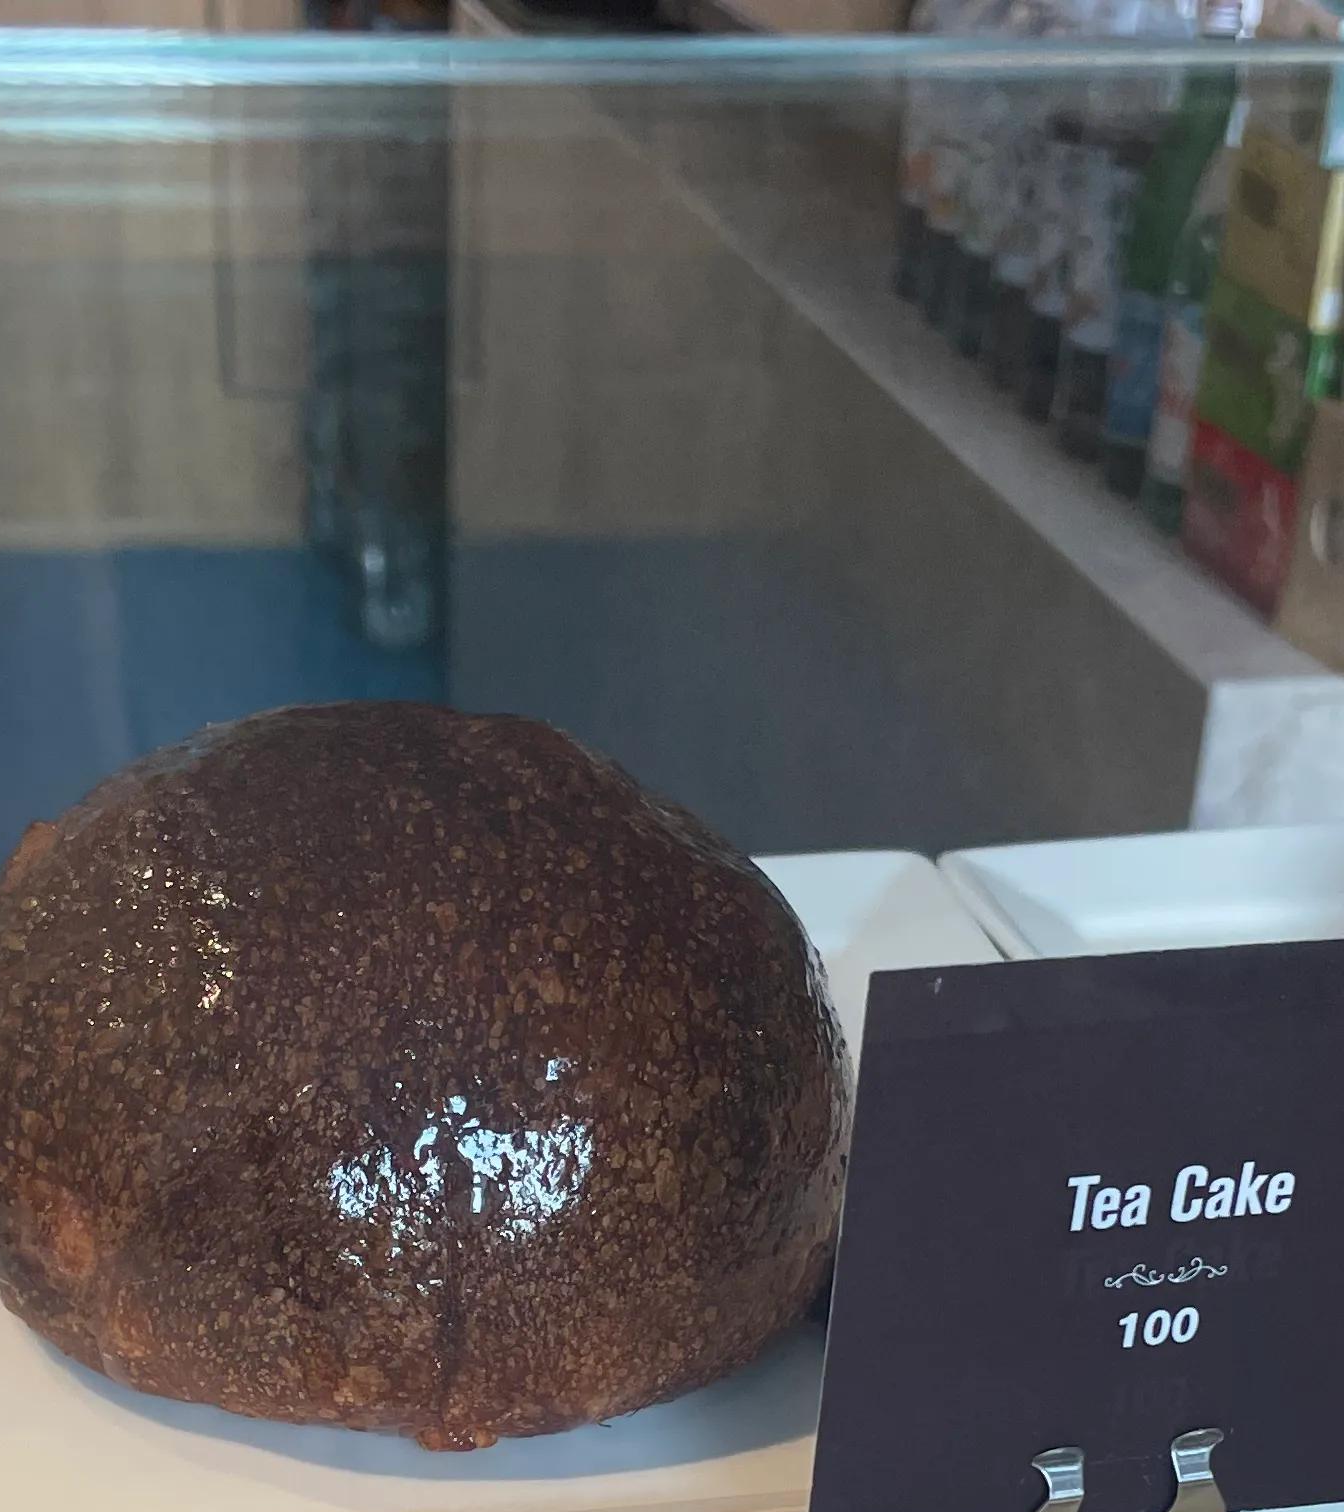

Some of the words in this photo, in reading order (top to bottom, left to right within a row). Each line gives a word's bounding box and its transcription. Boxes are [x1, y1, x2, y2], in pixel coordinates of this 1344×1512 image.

[1067, 1174, 1152, 1232] Tea
[1169, 1160, 1296, 1223] Cake
[1118, 1306, 1200, 1348] 100
